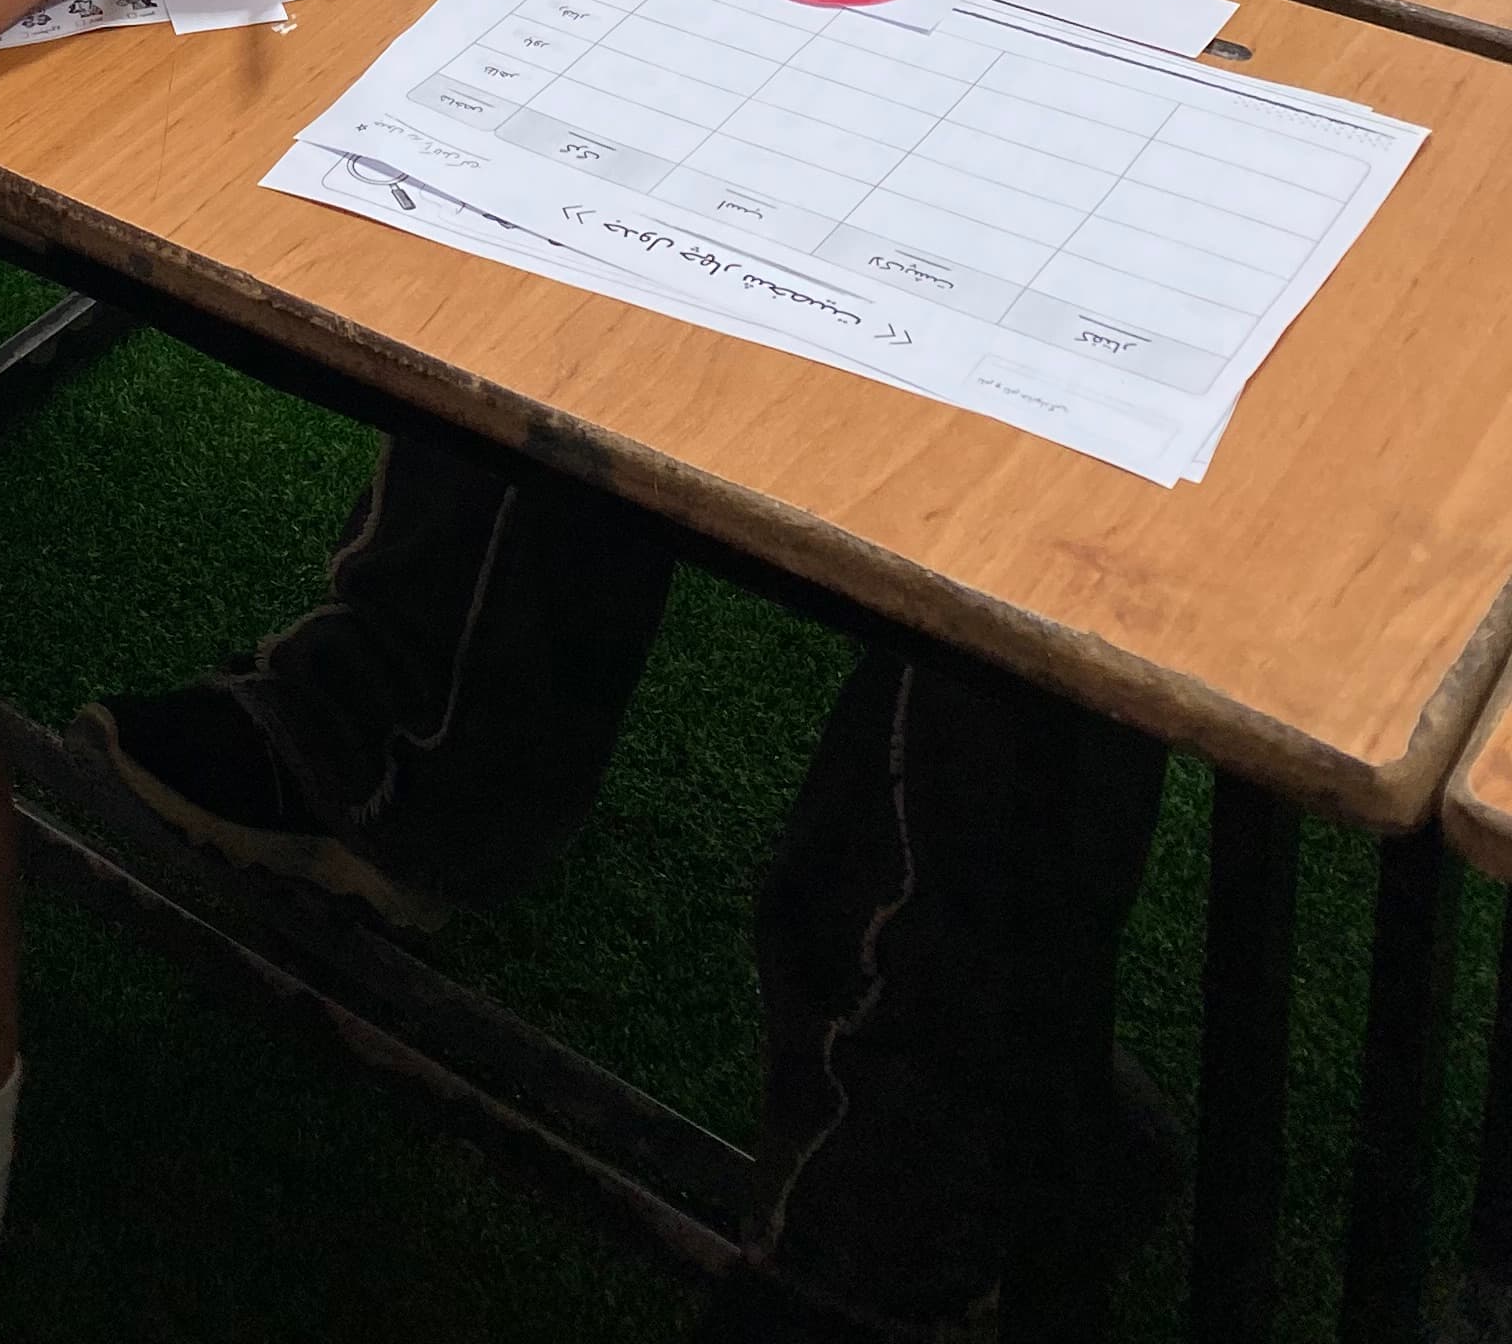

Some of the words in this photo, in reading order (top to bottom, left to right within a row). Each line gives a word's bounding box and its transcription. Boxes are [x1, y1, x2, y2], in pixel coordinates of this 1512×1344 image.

[558, 5, 591, 21] رفتار
[523, 37, 551, 48] باور
[483, 66, 520, 79] ظاهر
[560, 144, 600, 160] گرگ
[717, 200, 763, 220] اسب
[603, 219, 675, 252] جدول
[680, 246, 742, 275] چهار
[742, 274, 862, 326] شخصیت
[1074, 331, 1138, 354] کفتار
